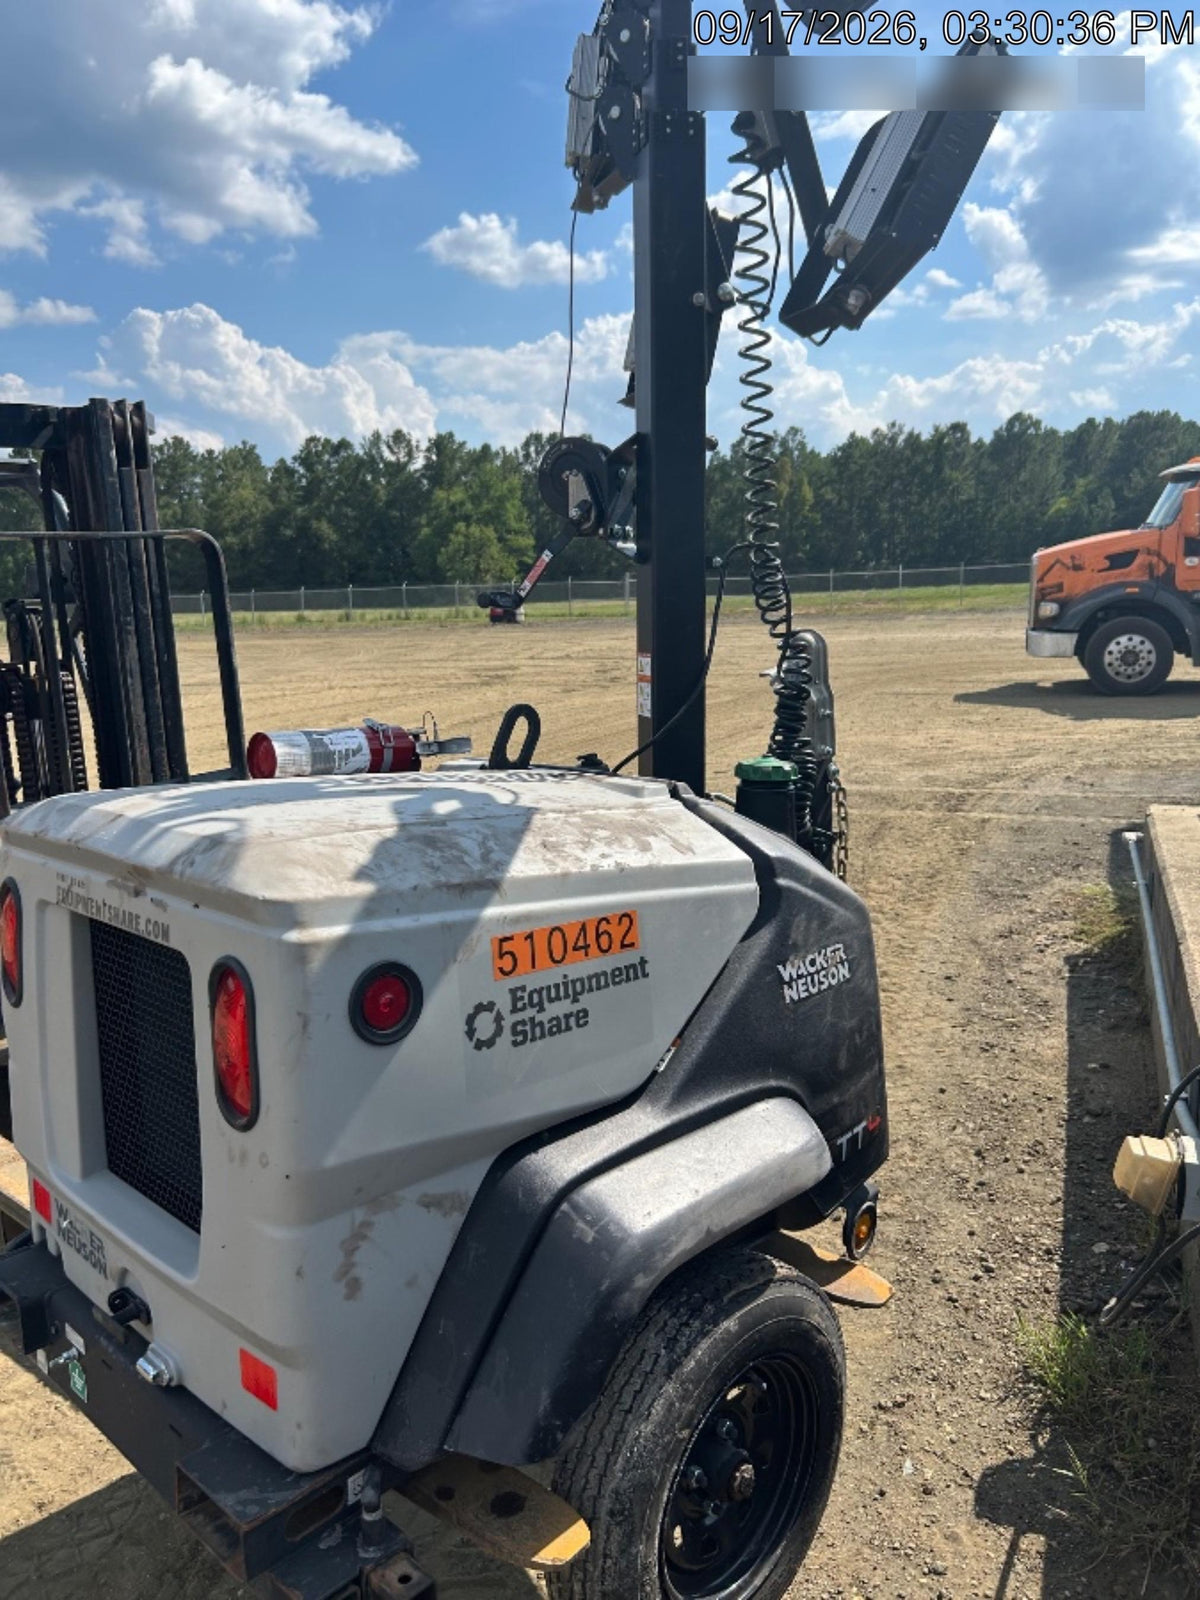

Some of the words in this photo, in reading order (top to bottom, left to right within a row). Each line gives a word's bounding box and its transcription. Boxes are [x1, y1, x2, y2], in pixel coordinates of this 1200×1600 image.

[497, 911, 636, 977] 510462
[508, 955, 650, 1015] Equipment
[783, 961, 851, 1004] NEUSON
[511, 1007, 590, 1048] Share
[57, 1218, 109, 1281] NEUSON
